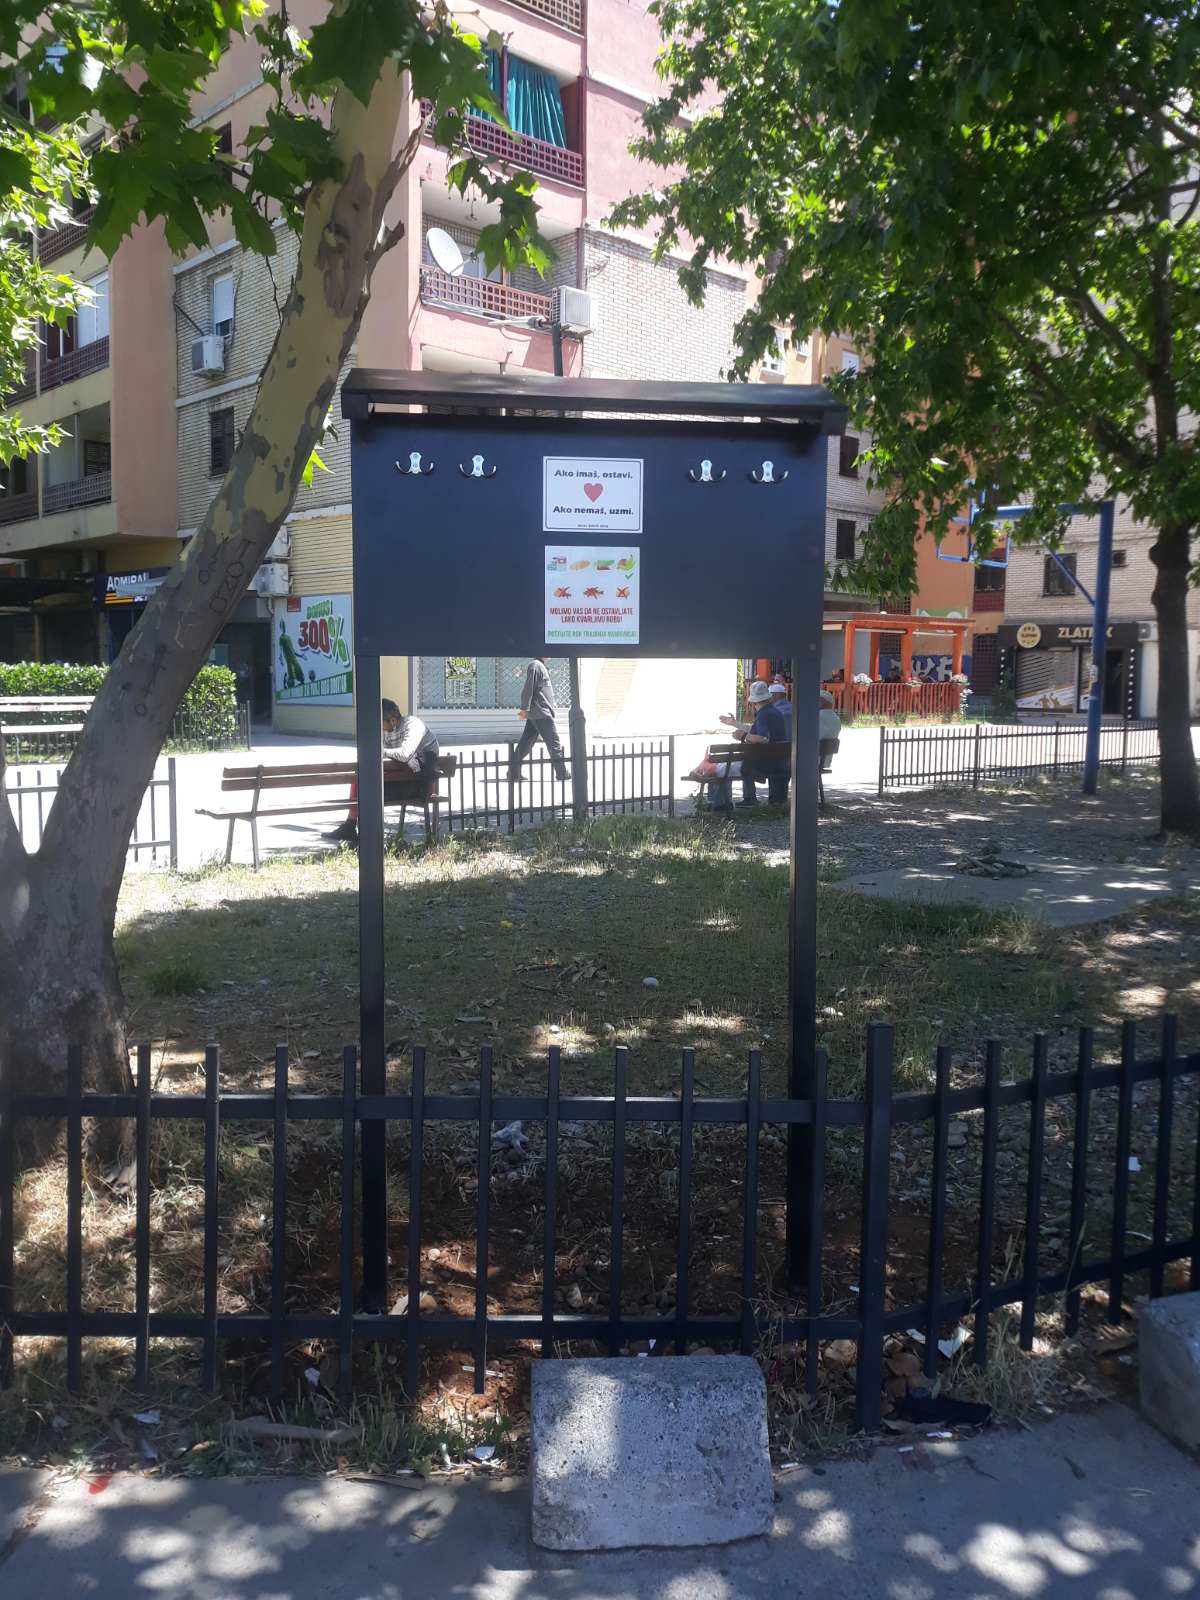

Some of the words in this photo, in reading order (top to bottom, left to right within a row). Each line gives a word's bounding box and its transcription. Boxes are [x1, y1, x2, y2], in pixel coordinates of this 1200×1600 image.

[554, 469, 574, 477] Ako
[576, 470, 600, 479] imaš,
[602, 471, 633, 479] ostavi.
[553, 506, 572, 514] Ako
[574, 507, 607, 516] nemaš,
[609, 508, 634, 516] uzmi.
[550, 607, 571, 615] MOLIMO
[572, 607, 584, 615] VAS
[584, 607, 592, 615] DA
[593, 607, 600, 615] NE
[601, 607, 633, 616] OSTAVLJATE
[561, 615, 575, 624] LAKO
[297, 616, 351, 668] 300%
